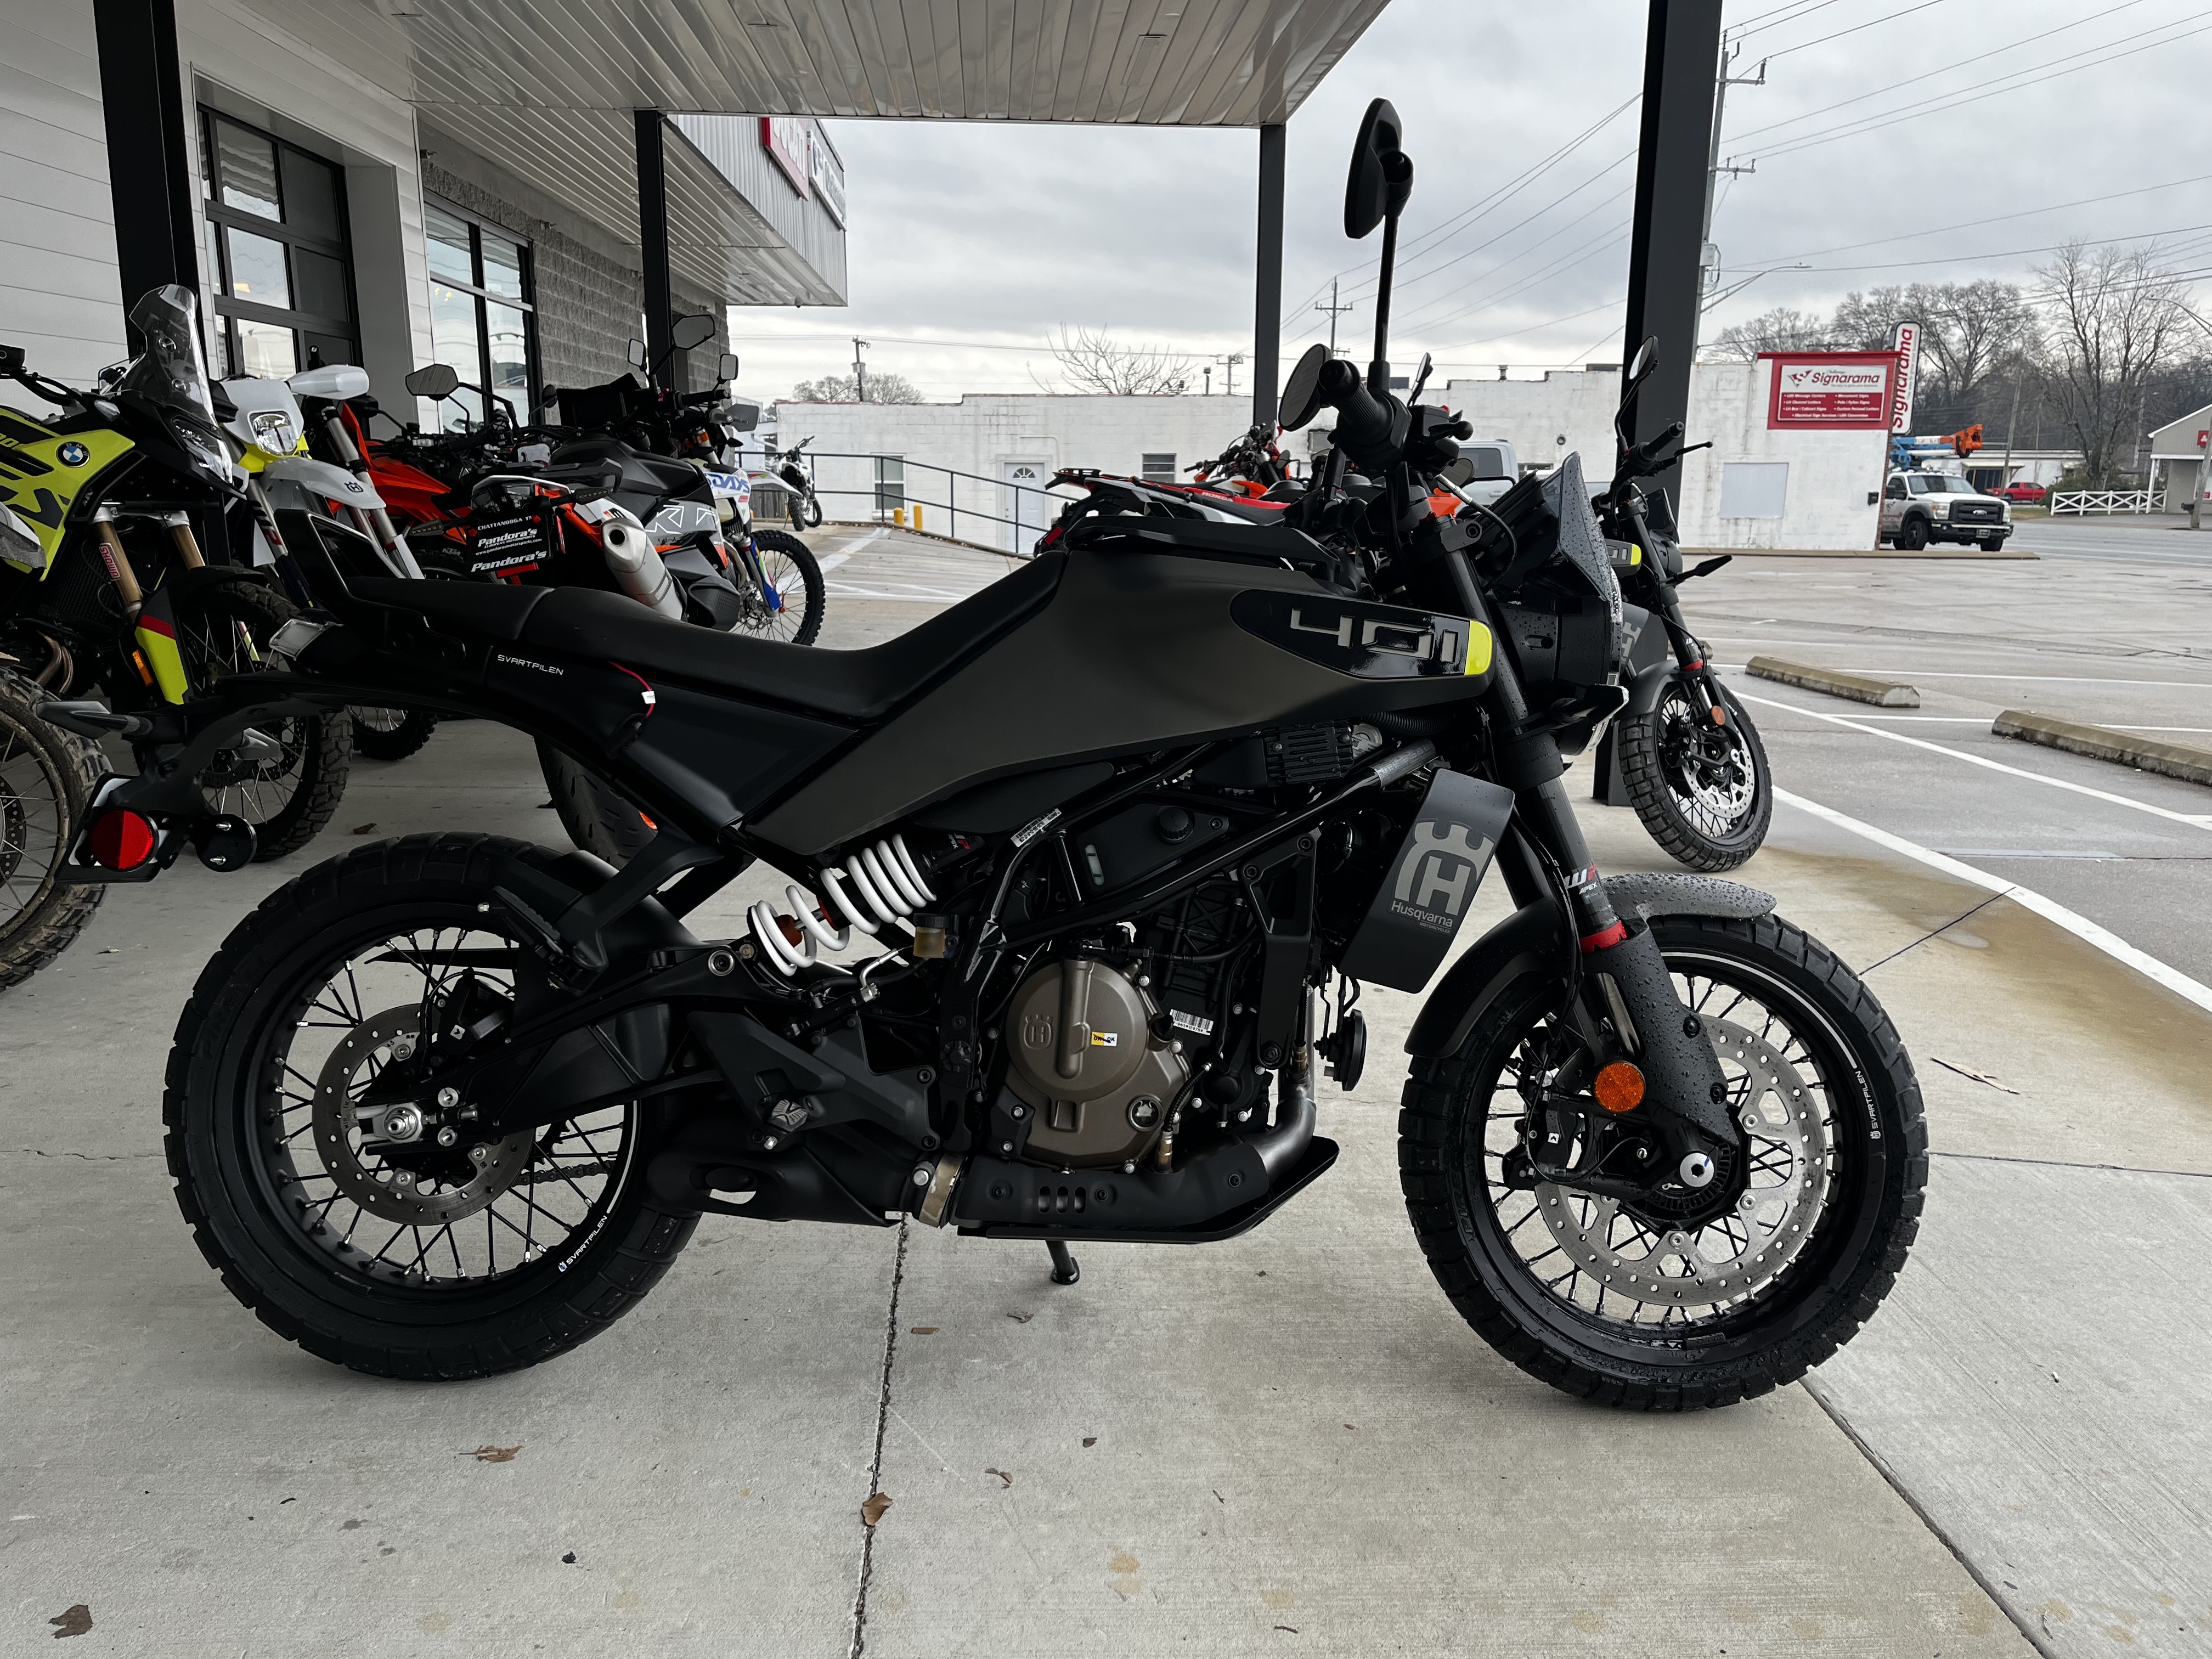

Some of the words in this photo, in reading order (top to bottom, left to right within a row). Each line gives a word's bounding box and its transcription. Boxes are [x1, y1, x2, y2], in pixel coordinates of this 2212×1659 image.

[1812, 373, 1880, 386] Signarama
[1893, 329, 1913, 428] Signarama
[1201, 492, 1234, 503] HONDA
[478, 518, 523, 531] CHATTANOOGA
[478, 528, 538, 548] Pandora's
[99, 546, 120, 577] SHOWA
[471, 551, 547, 572] Pandora's
[1289, 607, 1460, 664] 401
[497, 654, 564, 675] SVARTPILEN
[1579, 882, 1598, 895] APEX
[1391, 900, 1453, 928] Husqvarna
[1419, 921, 1452, 934] MOTORCYCLES
[1855, 1070, 1878, 1130] SVARTPILEN
[566, 1215, 608, 1265] SVARTPILEN
